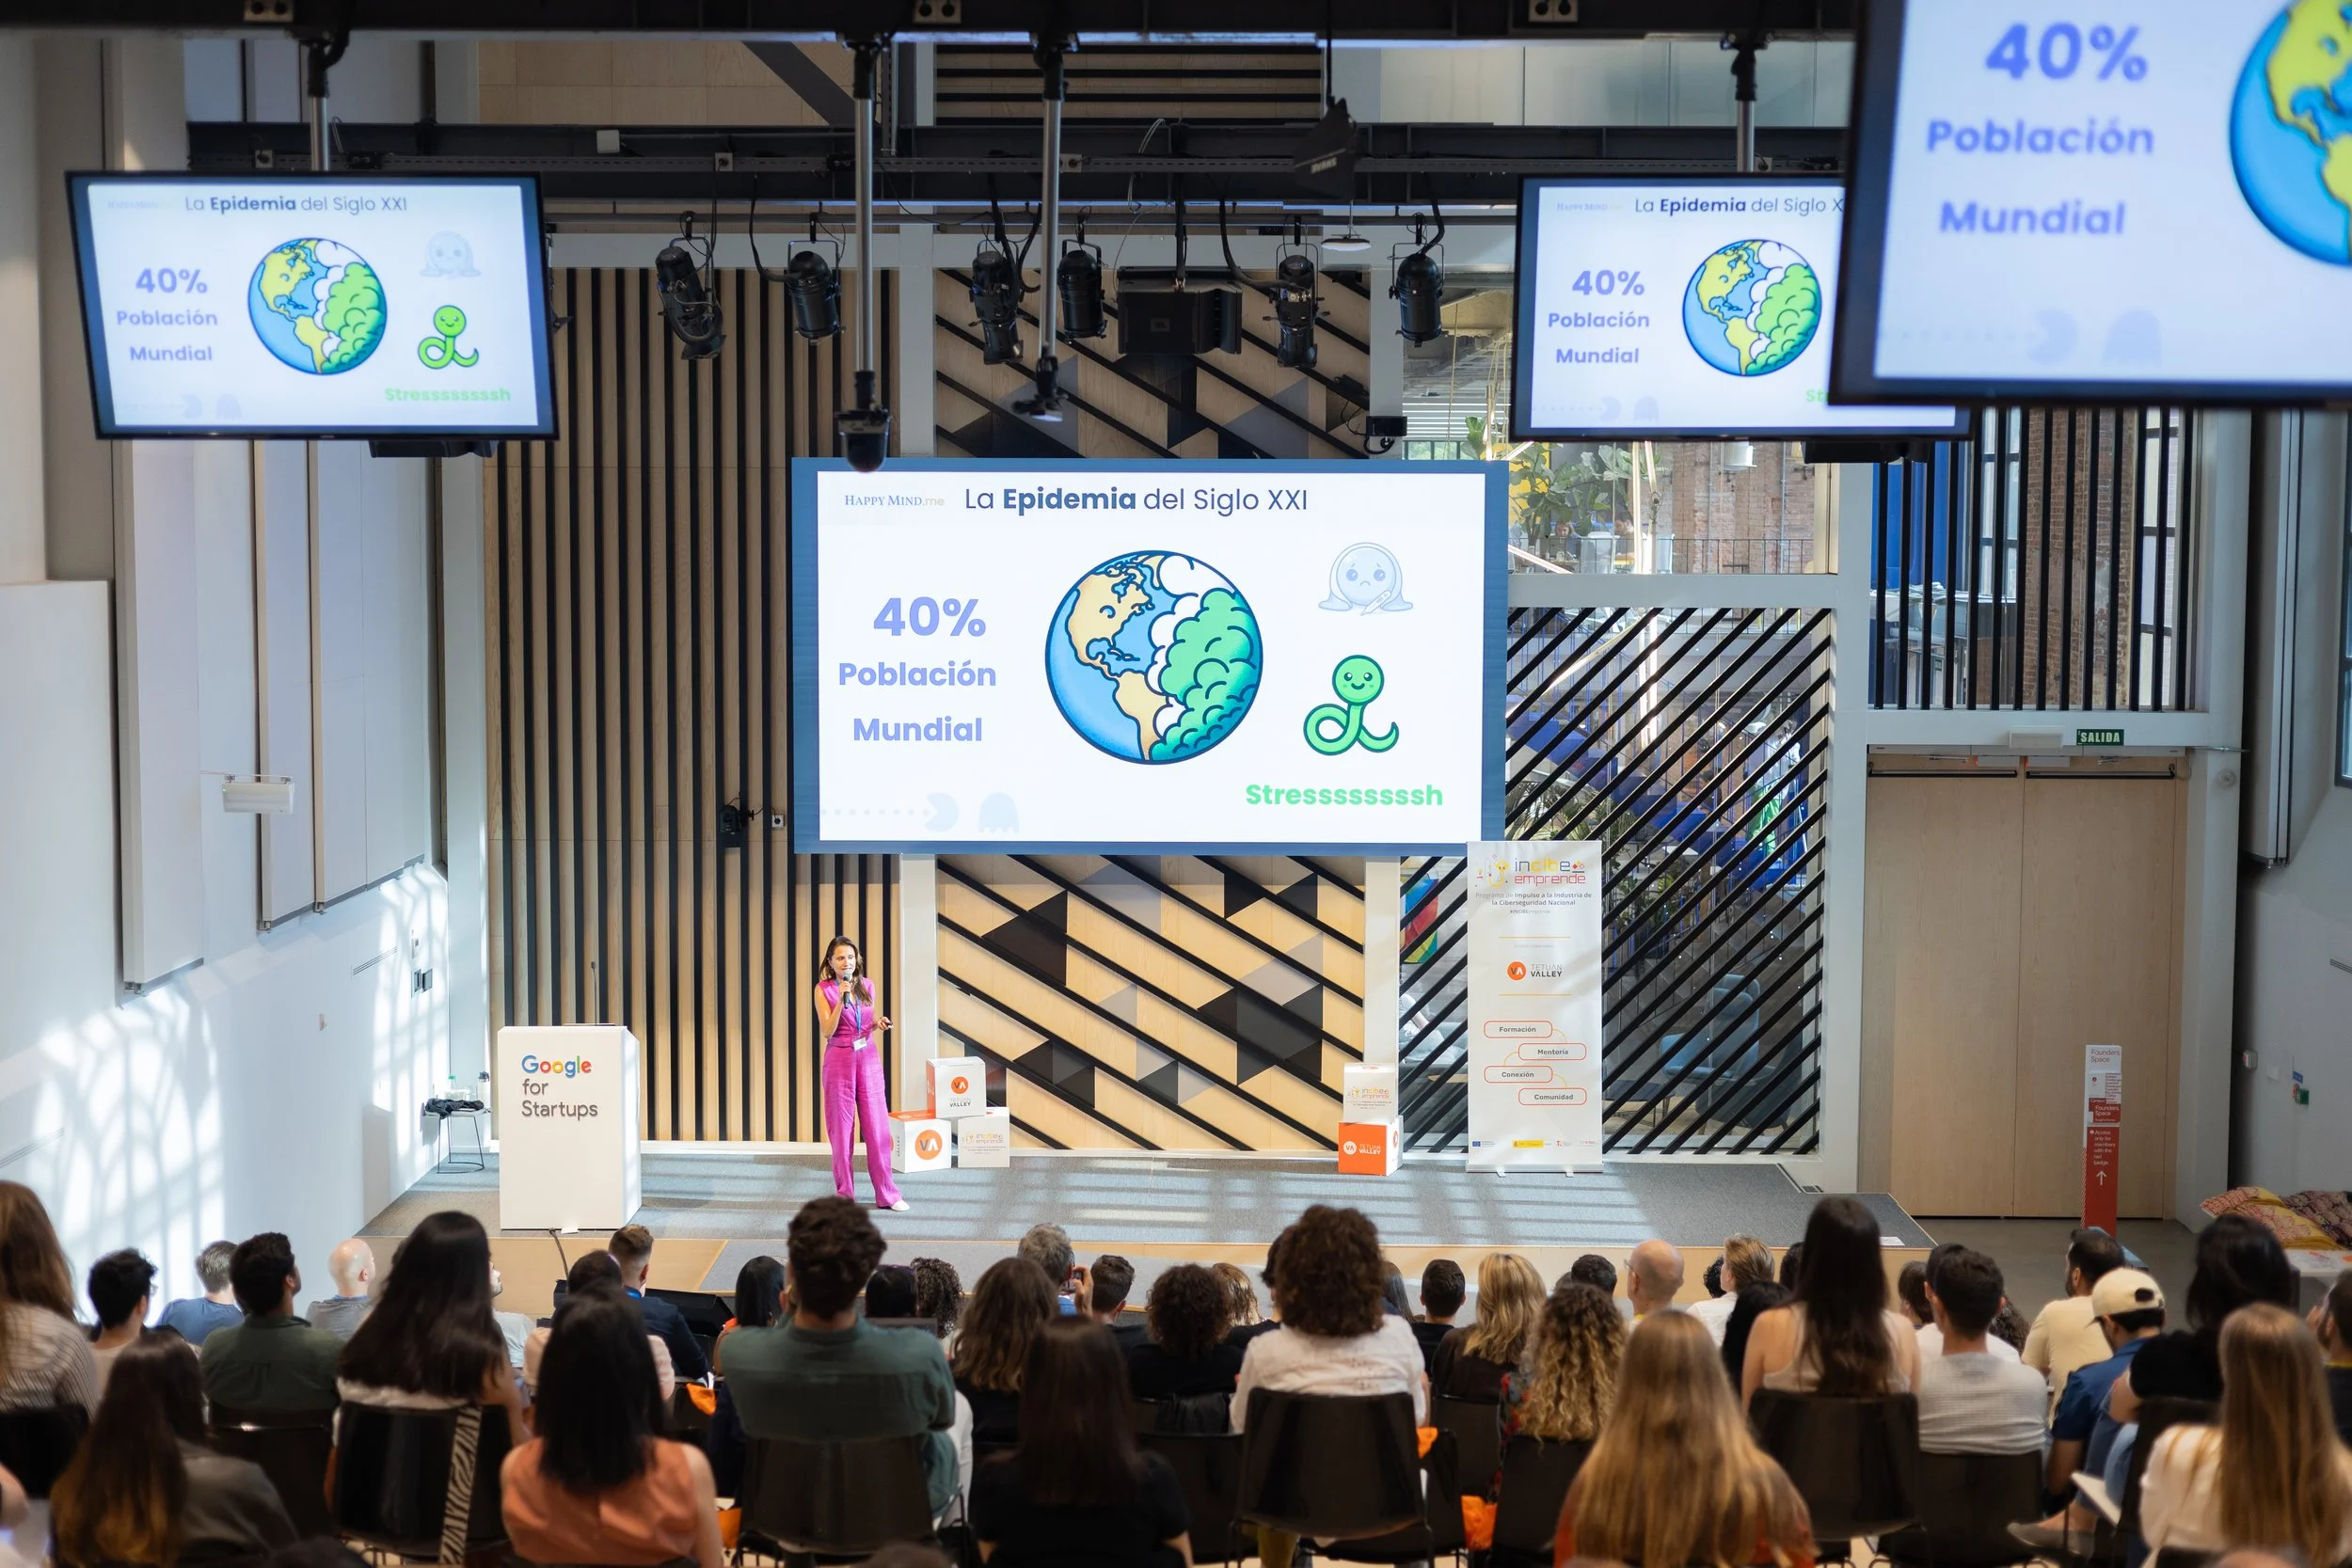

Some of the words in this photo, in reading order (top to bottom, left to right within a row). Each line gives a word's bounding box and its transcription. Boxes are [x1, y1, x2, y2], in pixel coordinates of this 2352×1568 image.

[1985, 22, 2150, 82] 40%
[1927, 117, 2154, 154] Población
[185, 197, 203, 211] La
[211, 196, 295, 214] Epidemia
[301, 197, 327, 211] del
[333, 196, 375, 215] Siglo
[381, 198, 407, 211] XXI
[1635, 198, 1653, 213] La
[1660, 197, 1746, 216] Epidemia
[1751, 198, 1778, 212] del
[1784, 198, 1826, 216] Siglo
[1939, 198, 2126, 234] Mundial
[135, 268, 208, 293] 40%
[1572, 270, 1645, 296] 40%
[117, 309, 218, 326] Población
[1548, 311, 1649, 328] Población
[130, 345, 213, 361] Mundial
[1556, 347, 1639, 364] Mundial
[844, 495, 885, 506] HAPPY
[965, 488, 993, 509] La
[1003, 486, 1136, 516] Epidemia
[1144, 488, 1184, 510] del
[1194, 487, 1259, 517] Siglo
[1268, 489, 1307, 510] XXI
[873, 596, 986, 637] 40%
[839, 659, 996, 686] Población
[853, 716, 982, 741] Mundial
[2081, 732, 2120, 742] SALIDA
[1515, 858, 1570, 872] incibe
[1515, 873, 1585, 886] emprende
[521, 1054, 592, 1078] Google
[522, 1078, 548, 1095] for
[521, 1100, 598, 1121] Startups
